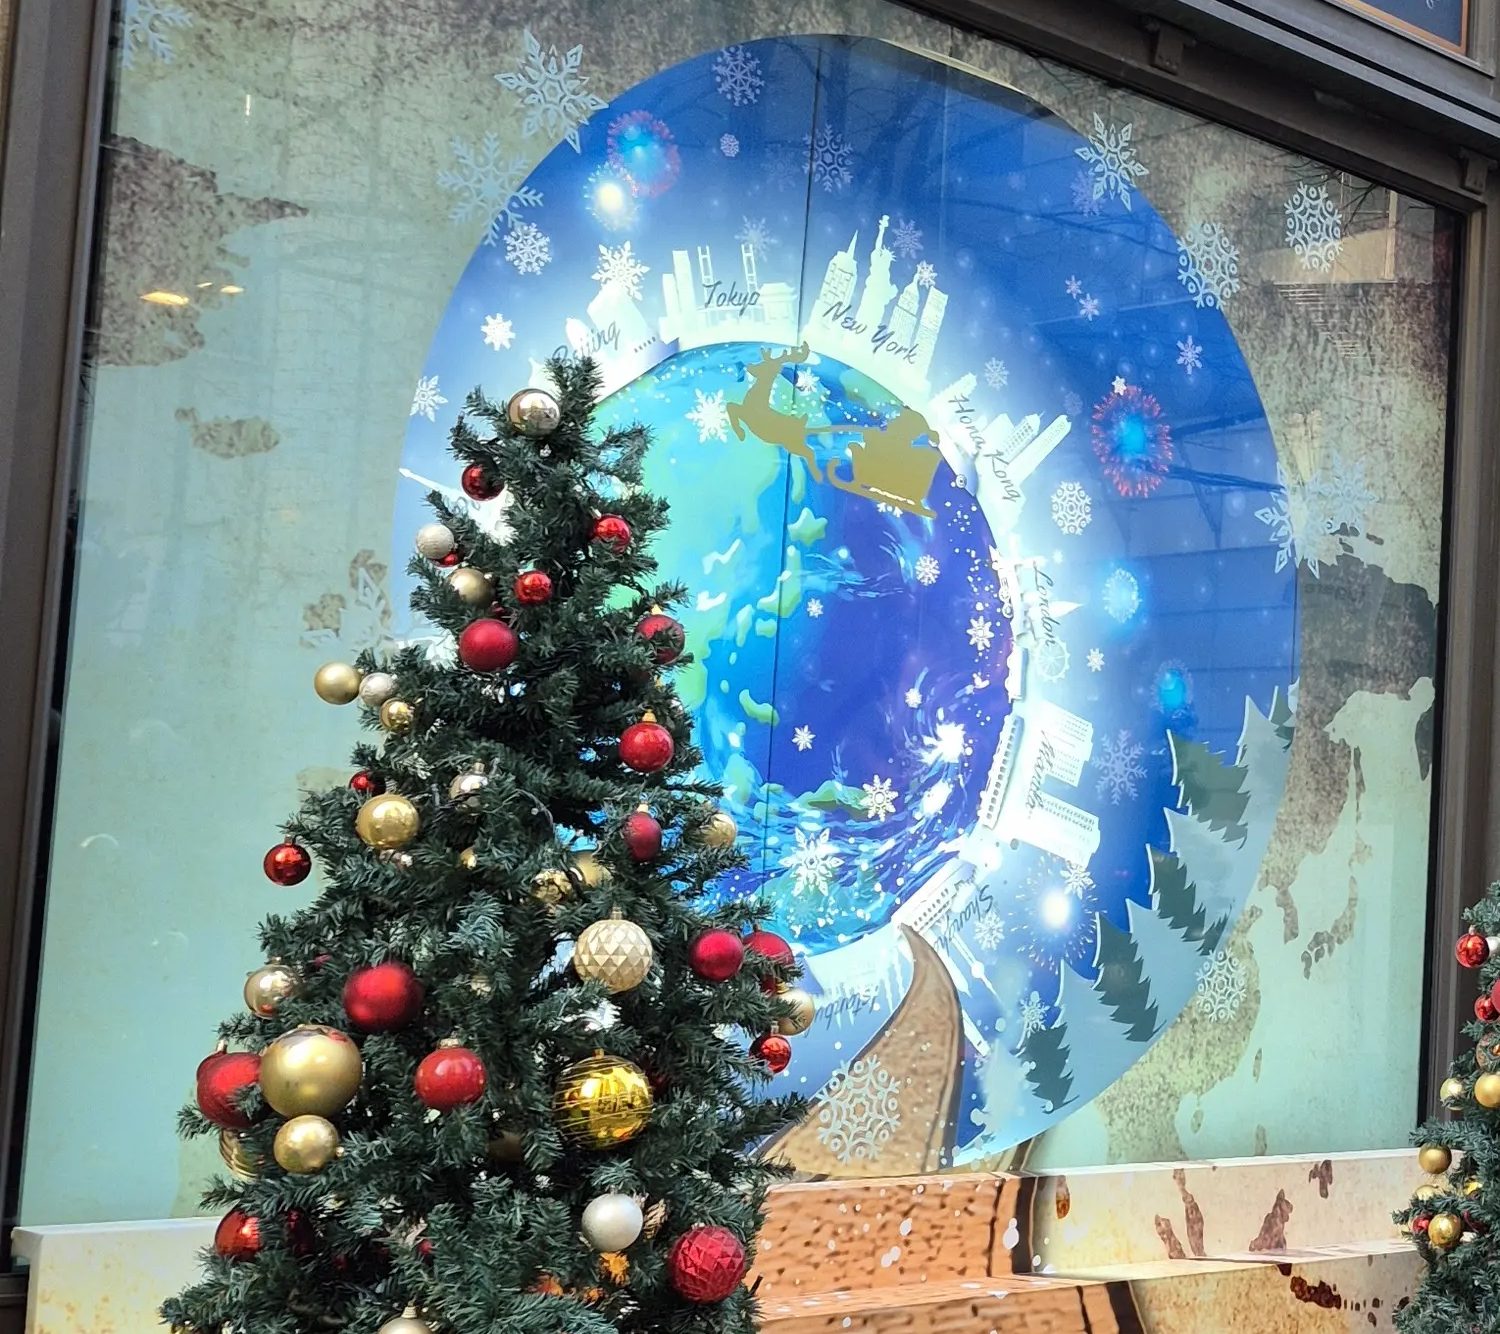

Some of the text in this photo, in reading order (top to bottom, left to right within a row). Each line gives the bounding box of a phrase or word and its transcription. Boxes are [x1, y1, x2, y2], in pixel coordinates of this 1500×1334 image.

[702, 281, 761, 316] Tokyo
[822, 300, 921, 365] New York
[948, 392, 1021, 503] Hong Kong
[1032, 559, 1061, 648] London
[1024, 729, 1056, 810] Manila
[933, 883, 994, 958] Shangh
[803, 992, 878, 1039] Istanbu
